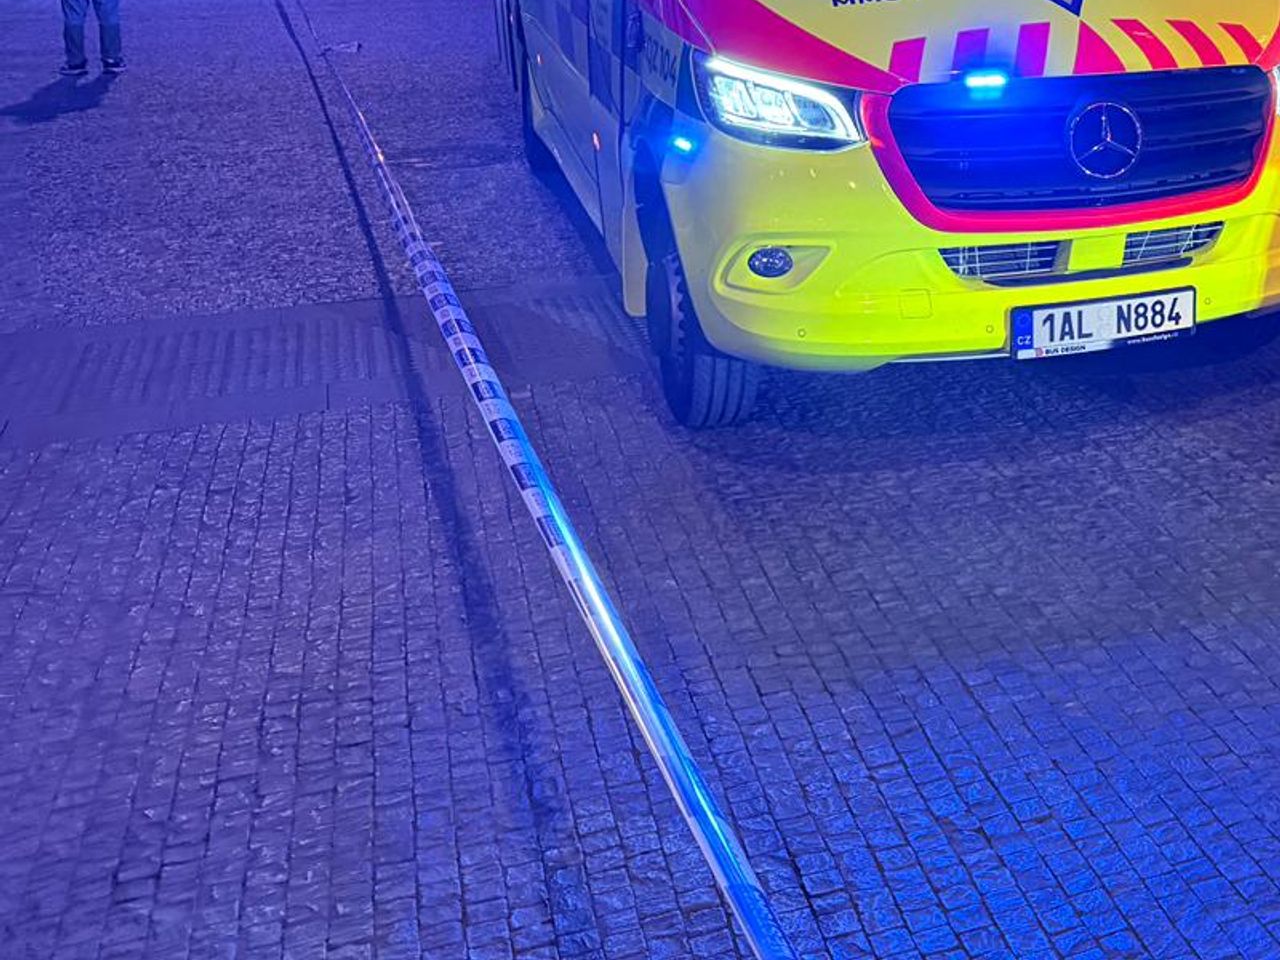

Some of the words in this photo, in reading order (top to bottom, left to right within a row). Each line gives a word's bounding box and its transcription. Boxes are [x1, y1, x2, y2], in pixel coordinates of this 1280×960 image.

[1042, 310, 1094, 342] 1AL
[1116, 297, 1182, 334] N884
[1017, 334, 1032, 346] CZ
